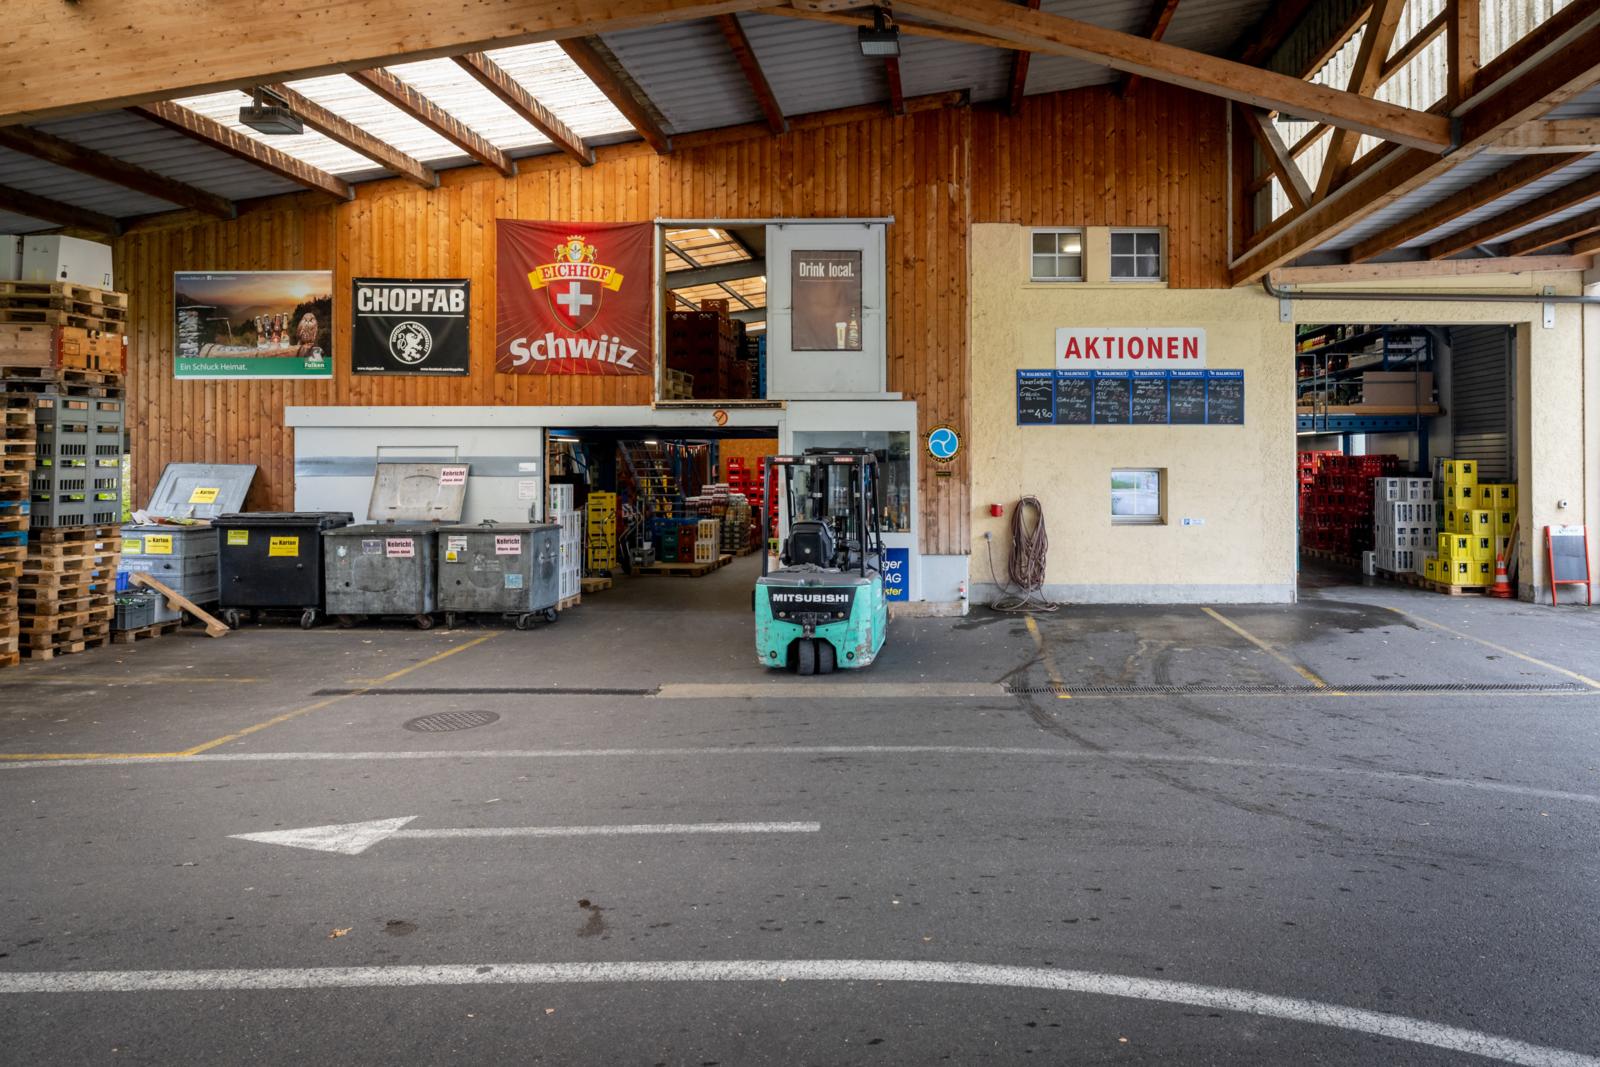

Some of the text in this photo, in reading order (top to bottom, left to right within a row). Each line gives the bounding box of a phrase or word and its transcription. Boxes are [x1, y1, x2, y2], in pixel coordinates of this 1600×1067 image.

[541, 263, 611, 280] EICHHOF
[799, 262, 855, 277] Drink local.
[357, 287, 465, 312] CHOPFAB
[509, 332, 638, 368] Schwiiz
[1064, 336, 1199, 359] AKTIONEN
[180, 363, 248, 371] Ein Schluck Heimat.
[772, 593, 849, 603] MITSUBISHI
